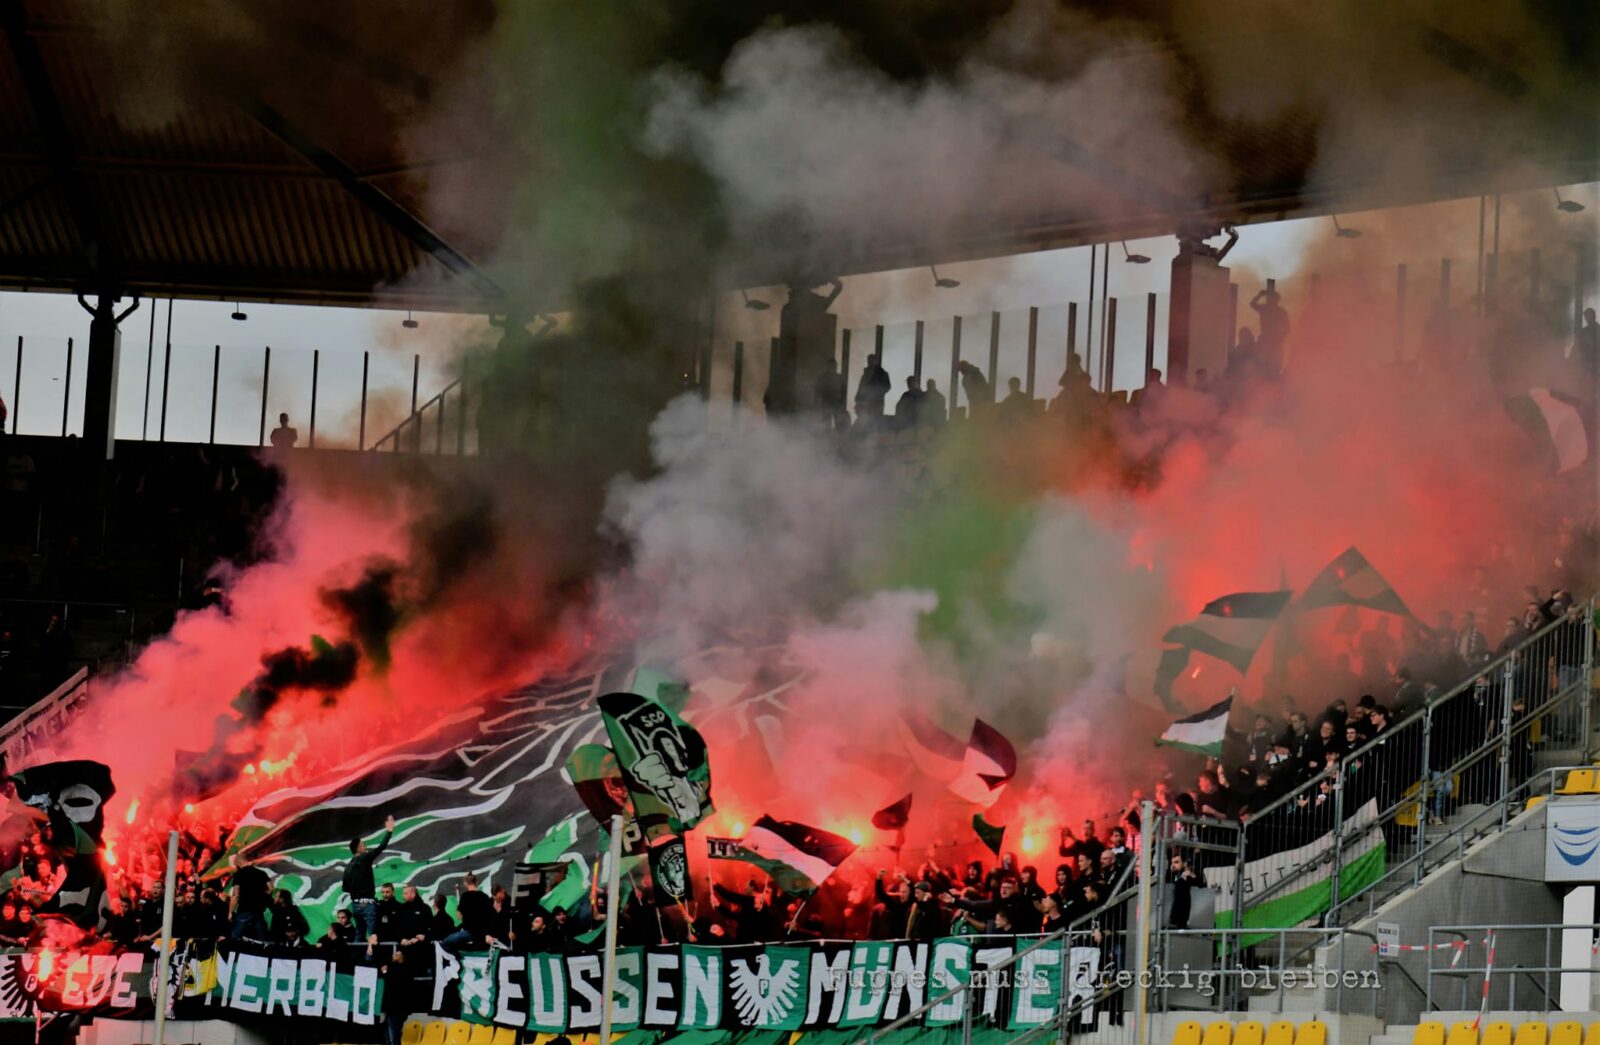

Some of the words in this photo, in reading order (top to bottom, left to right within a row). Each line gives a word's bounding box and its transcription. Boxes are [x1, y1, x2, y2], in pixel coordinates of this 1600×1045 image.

[640, 710, 666, 728] SCP
[432, 940, 721, 1027] PREUSSEN
[804, 943, 1101, 1025] MÜNSTER
